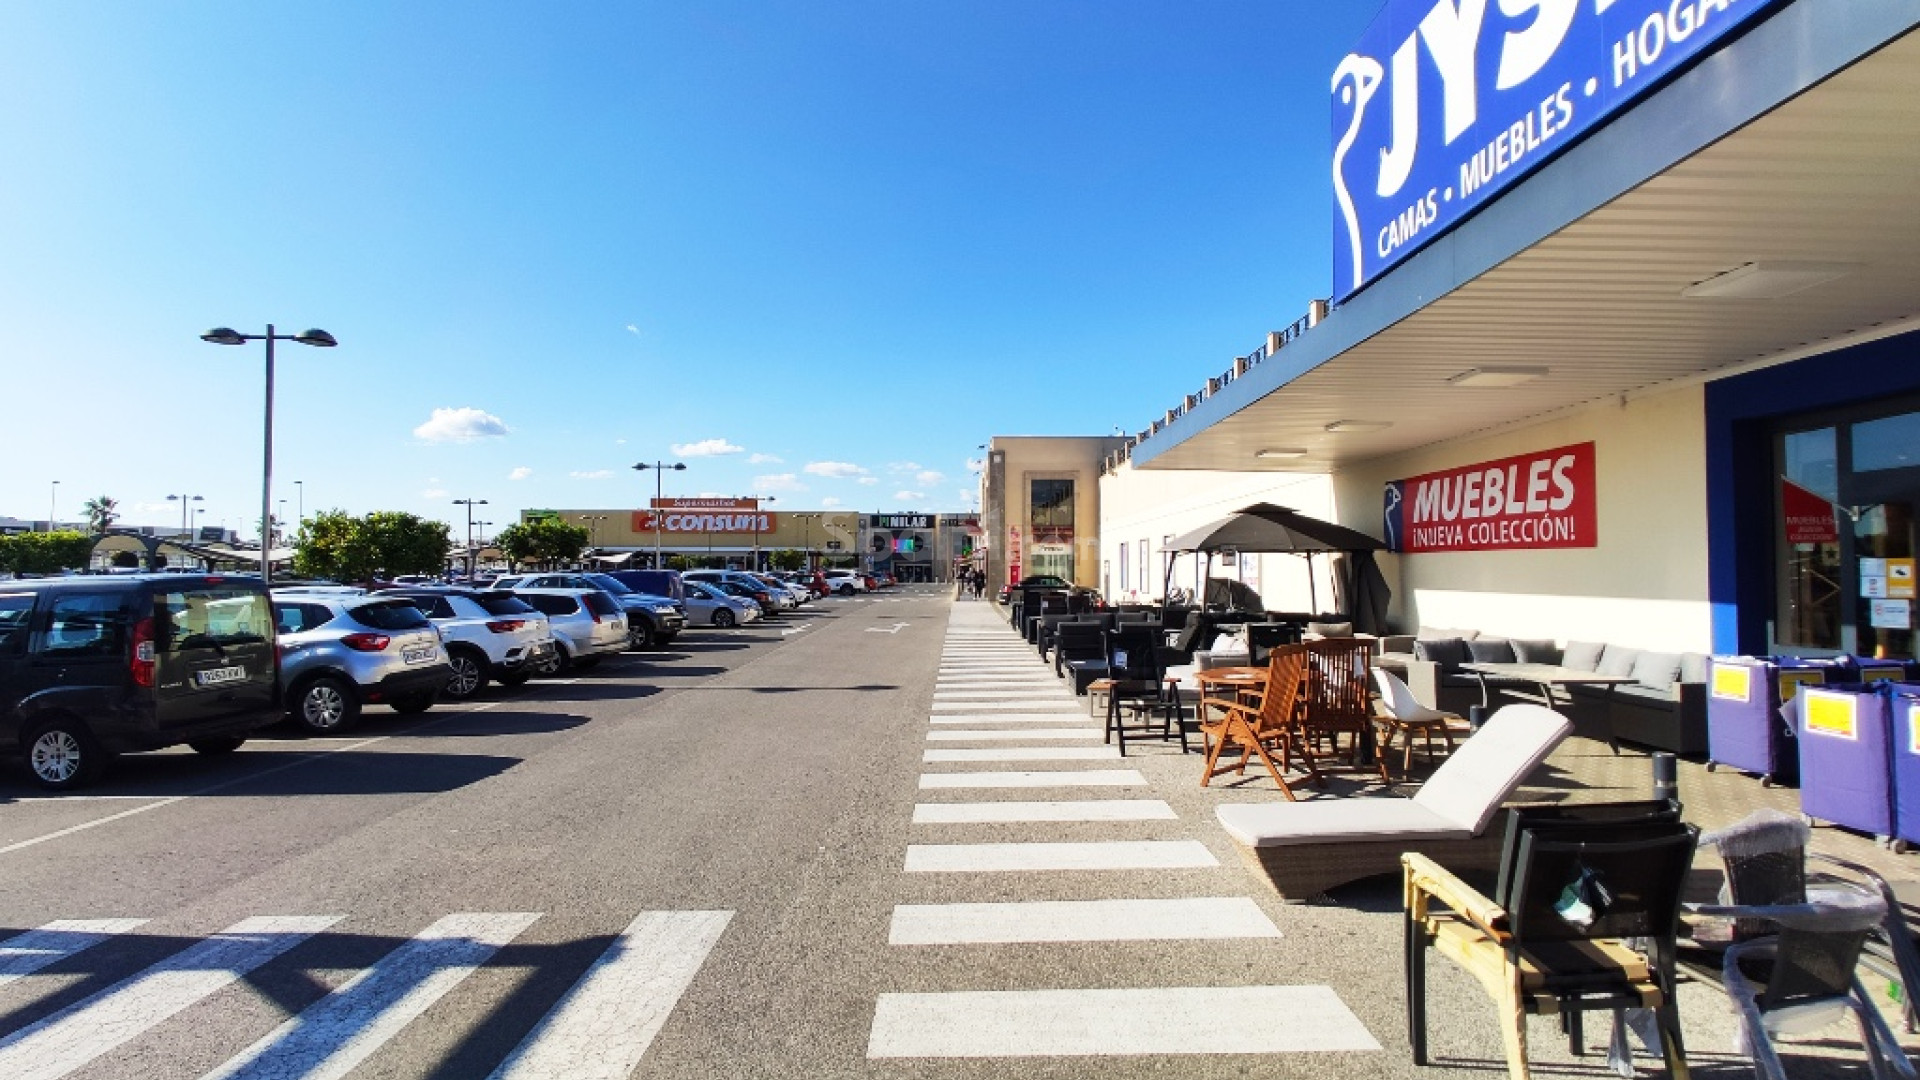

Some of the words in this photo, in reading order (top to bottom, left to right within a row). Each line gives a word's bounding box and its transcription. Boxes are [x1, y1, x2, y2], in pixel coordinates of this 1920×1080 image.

[1378, 187, 1438, 257] CAMAS
[1461, 82, 1573, 199] MUEBLES
[1413, 454, 1576, 523] MUEBLES
[665, 514, 769, 531] consum
[1413, 524, 1463, 548] ¡NUEVA
[1467, 513, 1576, 544] COLECCIÓN!
